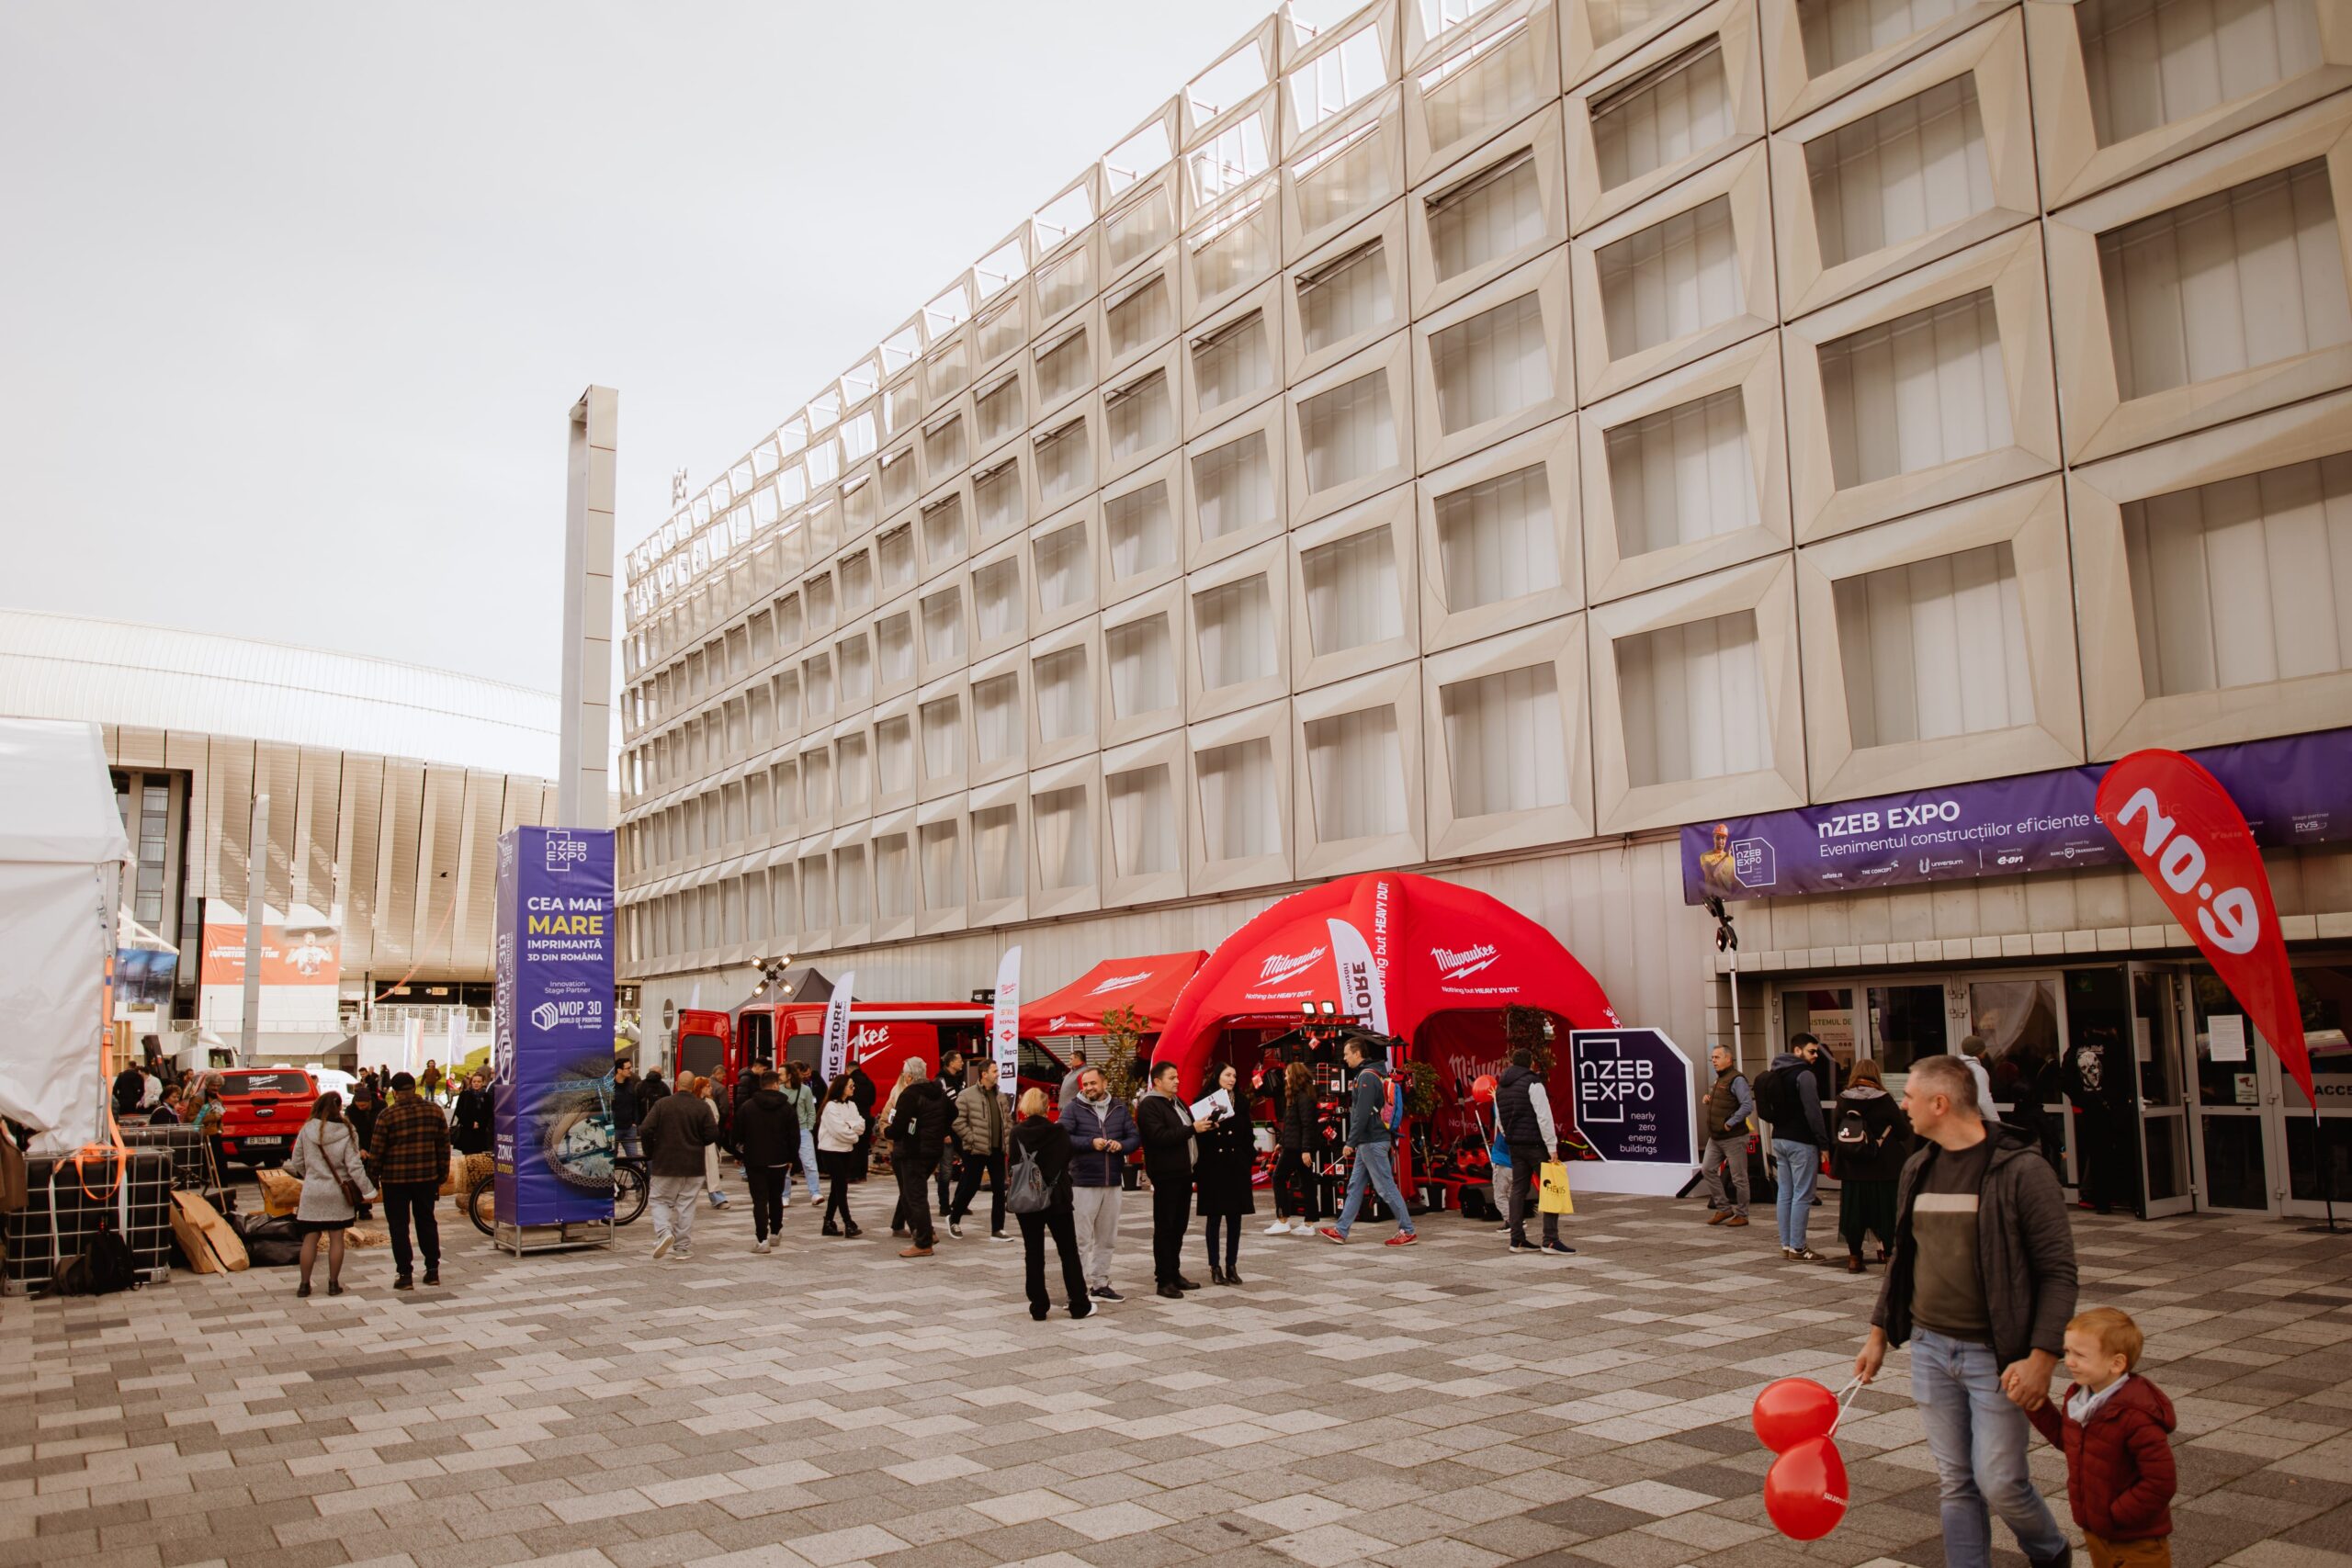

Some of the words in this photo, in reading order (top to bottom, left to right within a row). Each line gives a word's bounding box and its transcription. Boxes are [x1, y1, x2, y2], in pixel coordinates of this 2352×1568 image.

[1817, 812, 1880, 838] nZEB
[1887, 801, 1961, 829] EXPO
[2295, 820, 2319, 829] RVS
[1820, 834, 1907, 857] Evenimentul
[1911, 822, 2012, 846] construcțiilor
[2017, 814, 2090, 834] eficiente
[2094, 801, 2182, 825] engtic
[547, 840, 587, 852] nZEB
[546, 851, 587, 862] EXPO
[1736, 849, 1762, 859] nZEB
[1736, 856, 1762, 867] EXPO
[527, 897, 564, 911] CEA
[570, 897, 602, 911] MAI
[1375, 900, 1387, 934] HEAVY
[528, 915, 604, 935] MARE
[498, 935, 506, 964] 3D
[527, 938, 603, 950] IMPRIMANTĂ
[1374, 937, 1387, 955] but
[560, 952, 603, 961] ROMÂNIA
[1260, 944, 1329, 979] Milwaukee
[1430, 943, 1498, 972] Milwaukee
[1245, 992, 1267, 1001] Nothing
[1277, 991, 1296, 999] HEAVY
[1441, 986, 1464, 994] Nothing
[498, 974, 506, 1027] WOP
[559, 1001, 584, 1016] WOP
[588, 1001, 602, 1015] 3D
[831, 1000, 843, 1053] STORE
[829, 1056, 839, 1082] BIG
[1579, 1060, 1654, 1079] nZEB
[1582, 1082, 1654, 1100] EXPO
[1631, 1111, 1656, 1122] nearly
[1628, 1134, 1657, 1143] energy
[498, 1145, 513, 1161] ZONA
[1619, 1145, 1657, 1156] buildings
